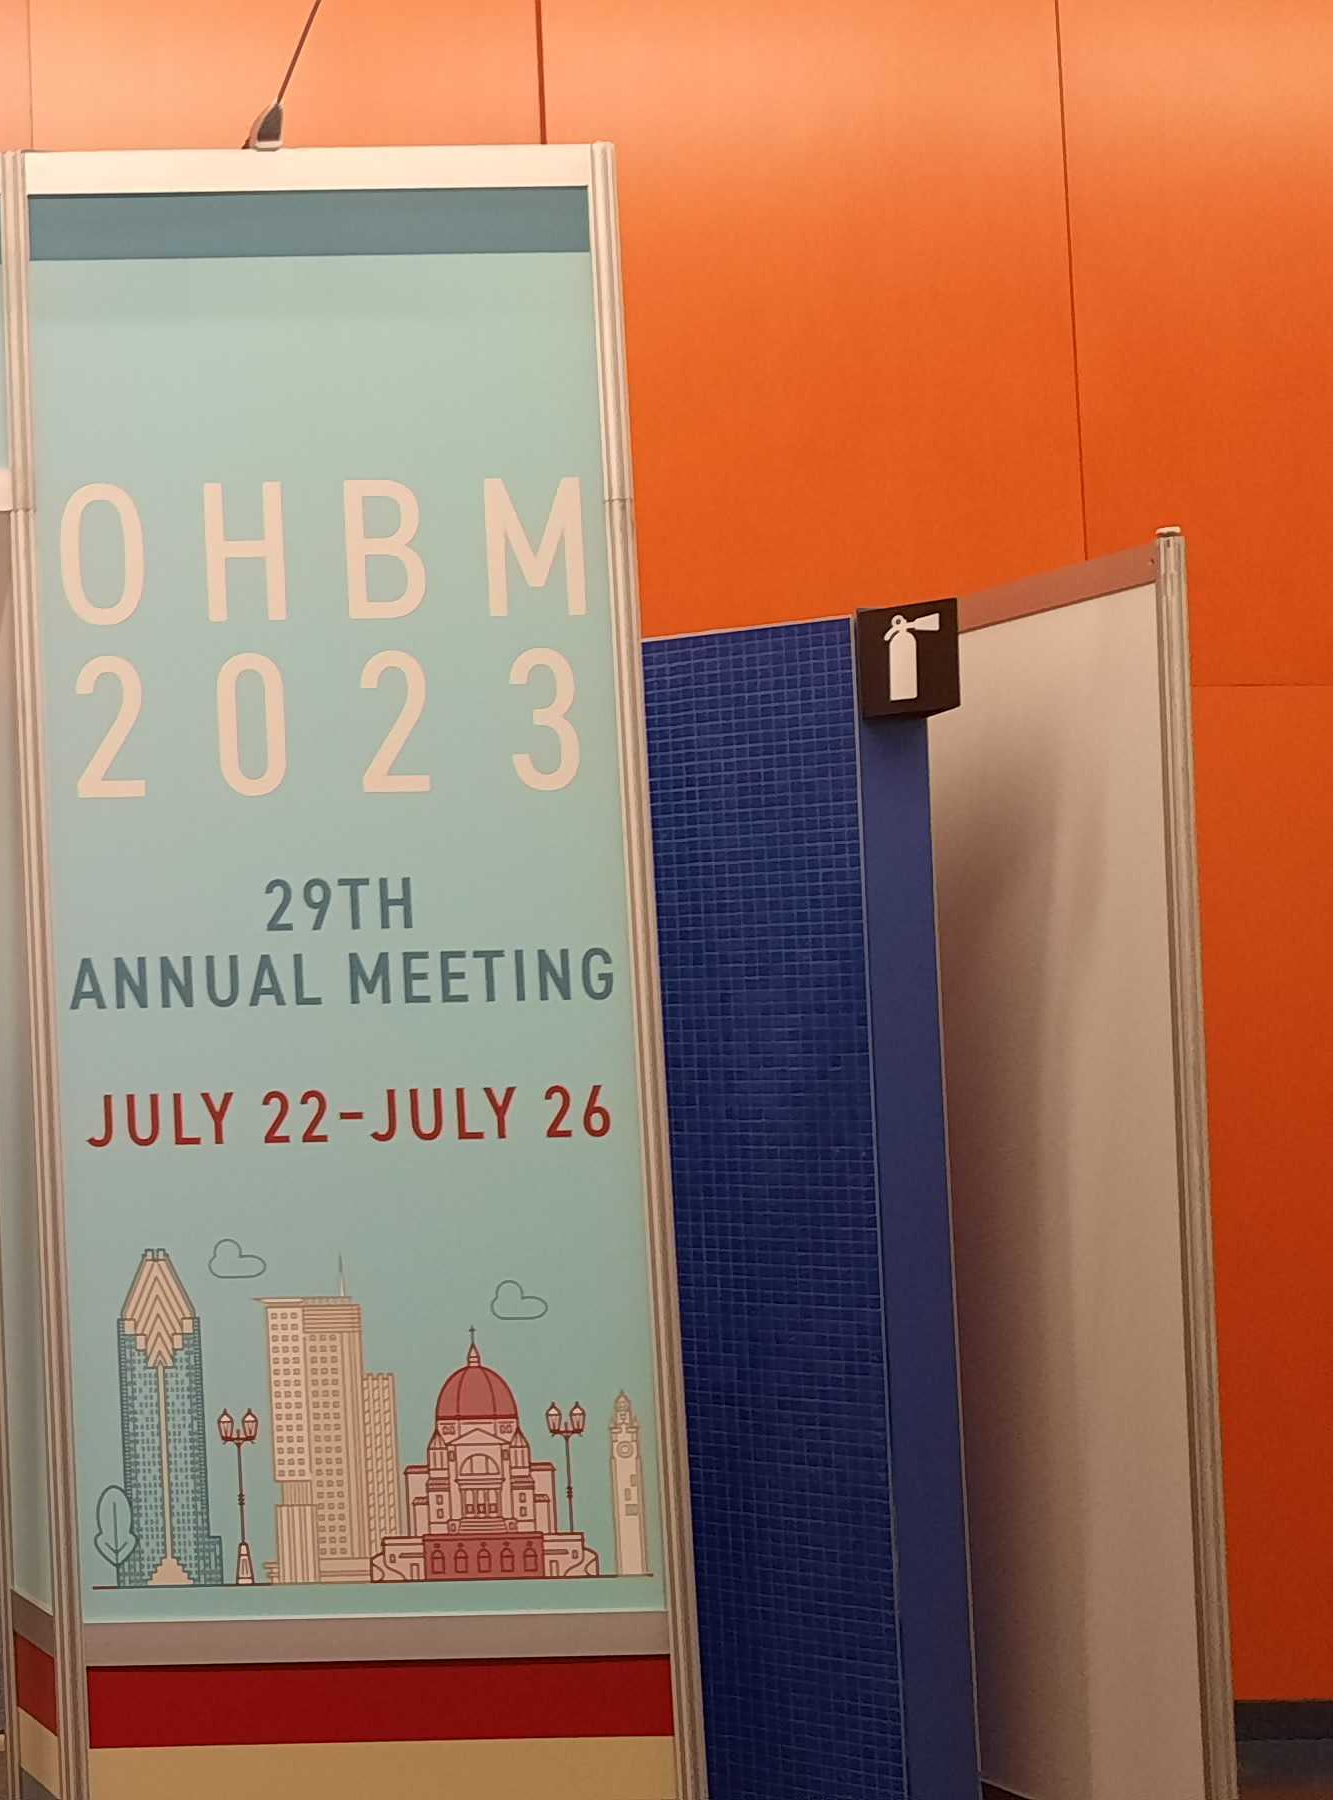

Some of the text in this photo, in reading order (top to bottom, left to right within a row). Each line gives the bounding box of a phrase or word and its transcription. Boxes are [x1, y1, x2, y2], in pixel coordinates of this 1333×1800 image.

[59, 477, 587, 626] OHBM
[75, 648, 582, 798] 2023
[265, 877, 413, 932] 29TH
[69, 948, 613, 1010] ANNUAL MEETING
[86, 1092, 233, 1147] JULY
[545, 1085, 610, 1138] 26
